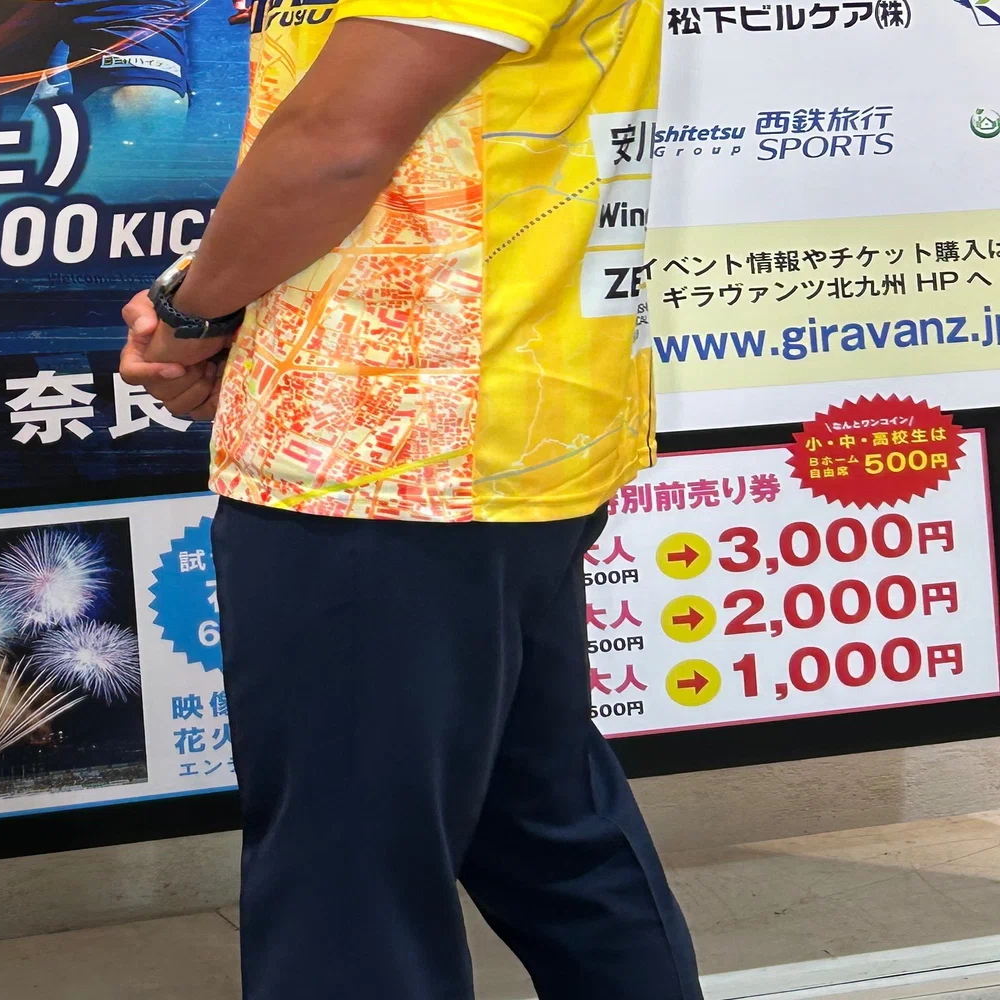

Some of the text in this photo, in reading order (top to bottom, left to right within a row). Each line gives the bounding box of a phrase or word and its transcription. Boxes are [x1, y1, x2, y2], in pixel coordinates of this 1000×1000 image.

[755, 105, 894, 136] 西鉄旅行
[756, 132, 894, 161] SPORTS
[109, 208, 216, 259] KIC
[662, 272, 906, 309] ギラヴァンツ北九州
[916, 271, 959, 292] HP
[652, 305, 1000, 364] www.giravanz.j
[4, 370, 192, 444] 奈良
[864, 449, 949, 475] 500円
[717, 513, 956, 575] 3,000円
[722, 574, 958, 637] 2,000円
[732, 637, 964, 701] 1,000円
